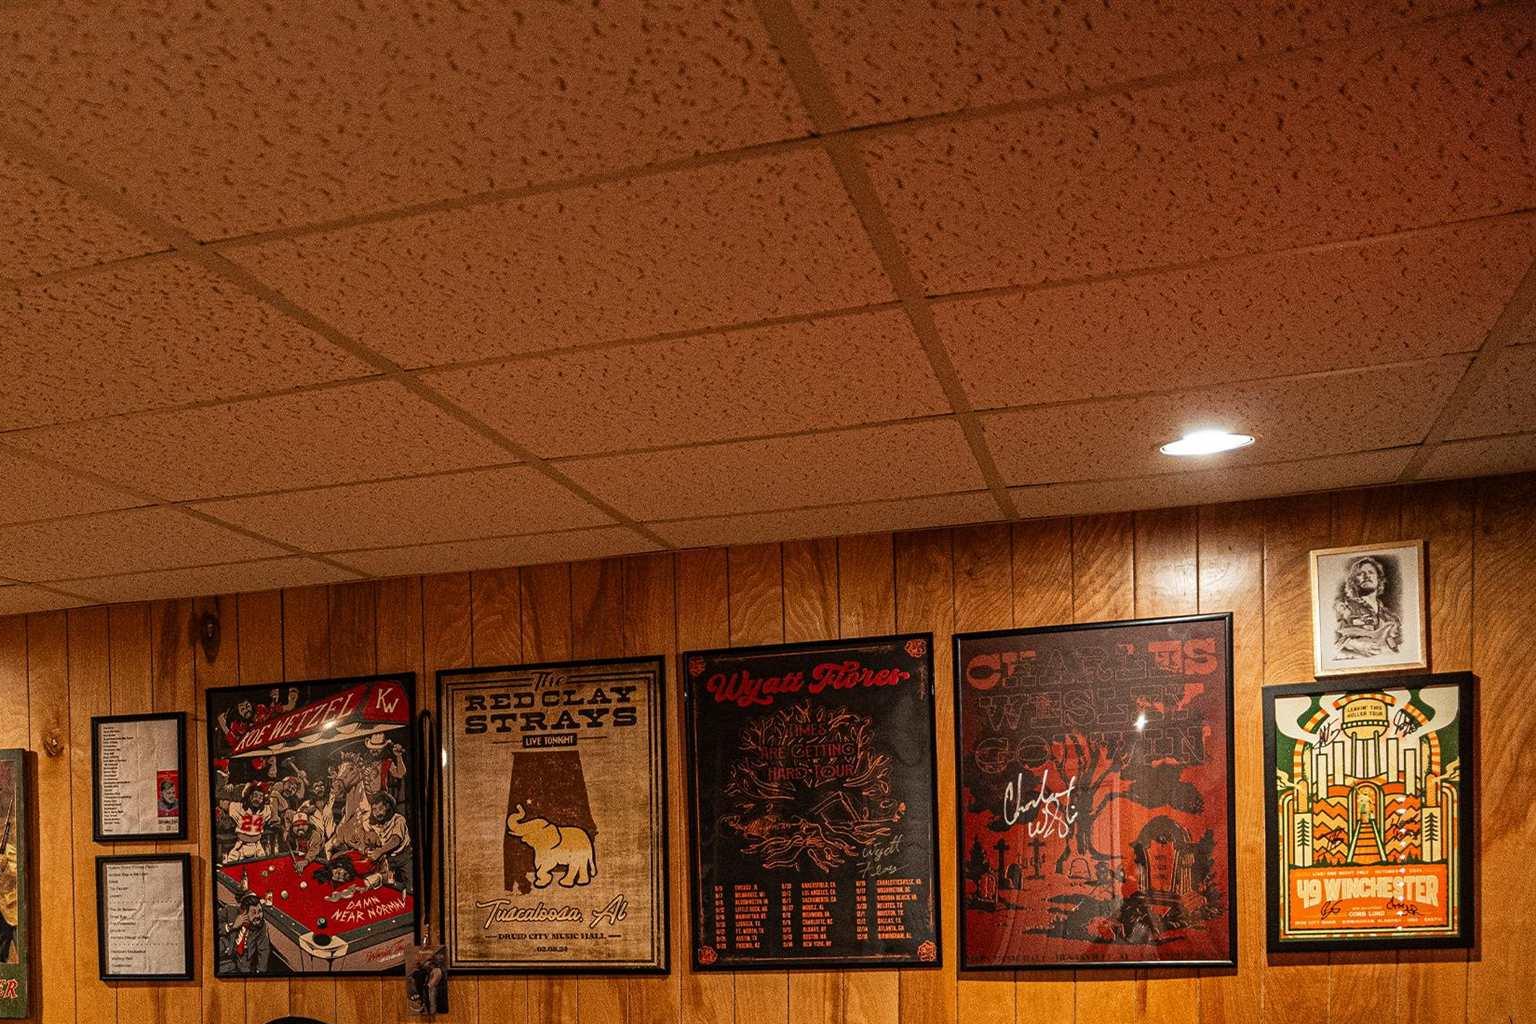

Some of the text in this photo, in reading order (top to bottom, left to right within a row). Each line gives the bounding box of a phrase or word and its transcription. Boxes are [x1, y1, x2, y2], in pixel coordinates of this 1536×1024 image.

[707, 672, 803, 705] Wyatt
[809, 660, 910, 692] Flores
[465, 686, 637, 711] RED CLAY
[235, 693, 355, 752] KOE WETZEL
[465, 707, 637, 734] STRAYS
[525, 737, 542, 747] LIVE
[1296, 879, 1322, 909] 49
[1324, 875, 1439, 907] WINCHESTER
[330, 908, 366, 923] NEAR
